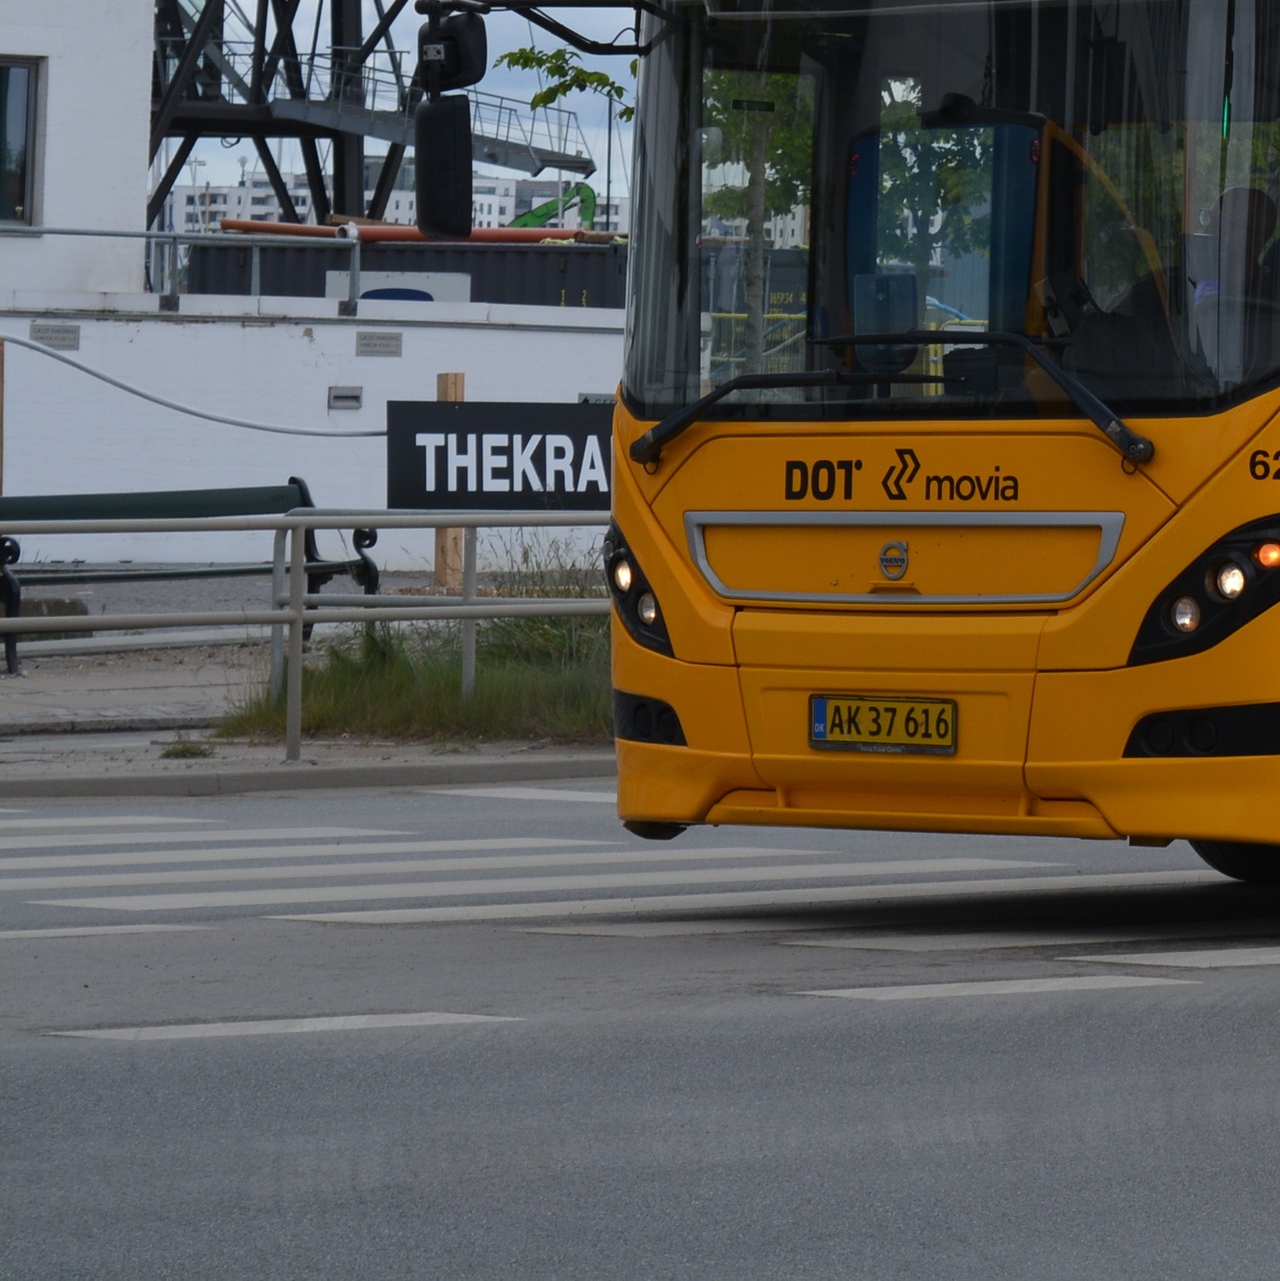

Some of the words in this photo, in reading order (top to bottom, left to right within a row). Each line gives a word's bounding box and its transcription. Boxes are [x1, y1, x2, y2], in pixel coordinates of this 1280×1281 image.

[415, 433, 613, 492] THEKRA
[925, 466, 1019, 501] movia
[814, 722, 825, 733] DK
[829, 705, 862, 735] AK
[868, 706, 897, 737] 37
[904, 707, 949, 739] 616
